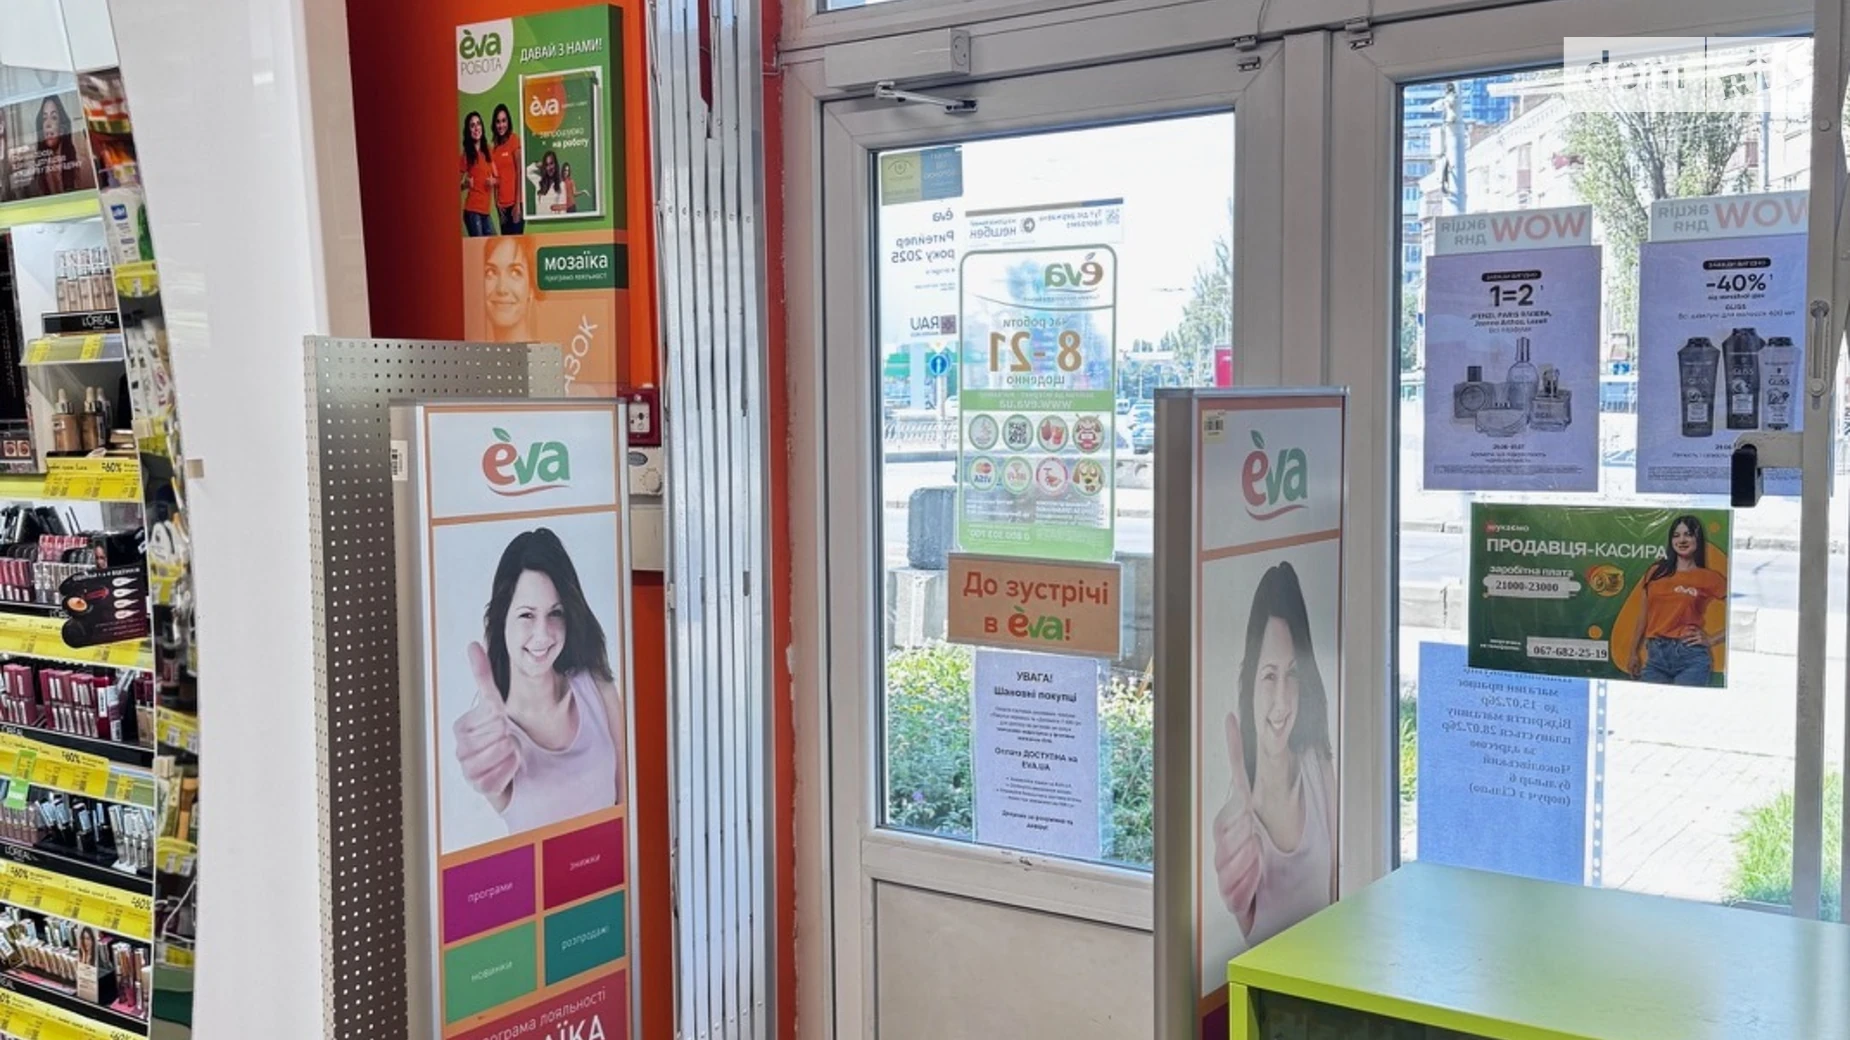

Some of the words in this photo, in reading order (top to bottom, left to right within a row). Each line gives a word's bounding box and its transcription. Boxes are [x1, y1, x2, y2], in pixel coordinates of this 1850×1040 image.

[519, 43, 558, 63] ДАВАЙ
[558, 44, 566, 57] З
[566, 37, 602, 55] НАМИ!
[460, 57, 502, 76] РОБОТА
[544, 250, 609, 272] мозаїка
[1706, 272, 1766, 292] -40%
[1490, 283, 1534, 307] 1=2
[482, 428, 571, 486] èva
[1242, 430, 1309, 506] èva
[1486, 538, 1668, 561] ПРОДАВЦЯ-КАСИРА
[1489, 565, 1541, 576] заробітна
[1542, 568, 1574, 577] плата
[963, 571, 998, 598] До
[1006, 579, 1108, 607] зустрічі
[1495, 580, 1559, 592] 21000-23000
[984, 616, 998, 634] в
[1533, 645, 1608, 659] 067-682-25-19
[1016, 671, 1053, 683] УВАГА!
[994, 686, 1037, 699] Шановні
[1038, 692, 1077, 703] покупці
[994, 747, 1022, 757] Оплата
[1023, 750, 1067, 761] ДОСТУПНА
[569, 853, 601, 872] знижки
[467, 882, 513, 904] програми
[471, 961, 513, 983] новинки
[540, 986, 607, 1028] лояльності
